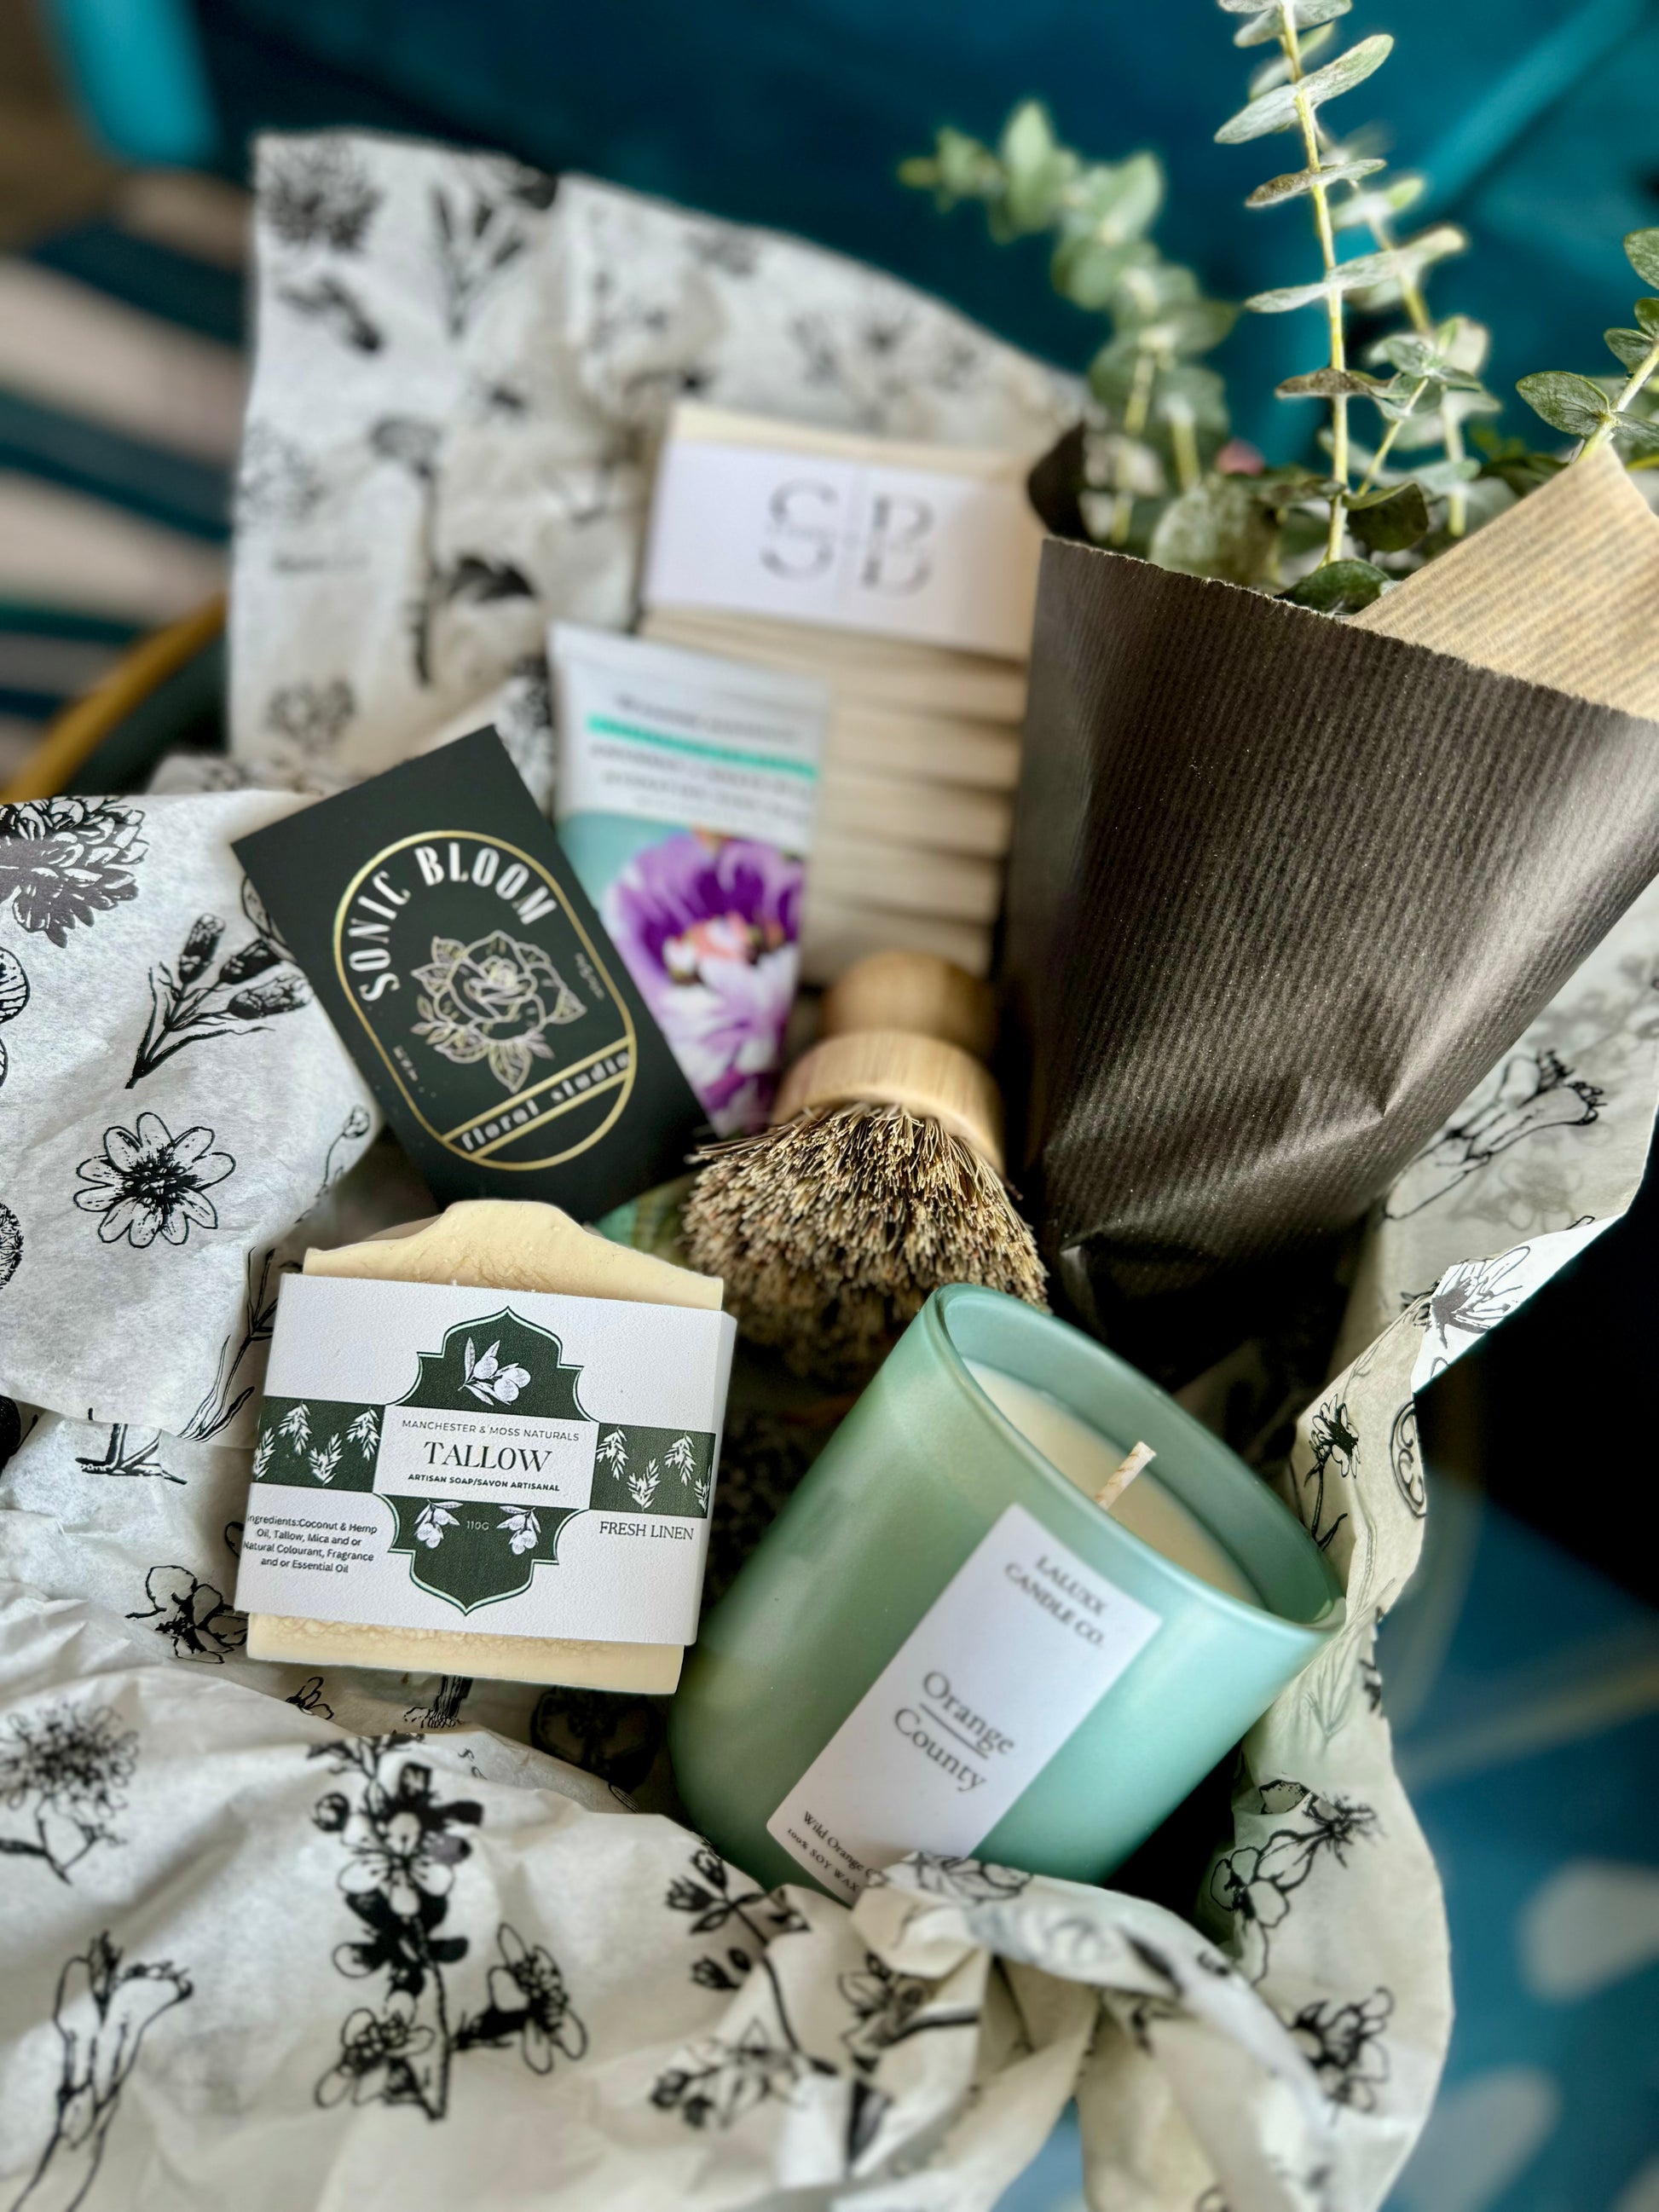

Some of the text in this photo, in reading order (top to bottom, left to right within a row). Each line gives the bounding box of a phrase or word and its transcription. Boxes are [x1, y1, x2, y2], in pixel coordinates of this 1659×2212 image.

[348, 842, 557, 1002] SONIC BLOOM
[461, 1052, 629, 1151] floral studio
[402, 1420, 477, 1434] MANCHESTER
[489, 1427, 520, 1436] MOSS
[524, 1429, 580, 1441] NATURALS
[424, 1441, 552, 1472] TALLOW
[408, 1474, 560, 1492] ARTISAN SOAP/SAVON ARTISANAL
[257, 1528, 271, 1539] Oil,
[274, 1530, 305, 1542] Tallow,
[308, 1533, 329, 1543] Mica
[332, 1536, 350, 1545] and
[349, 1523, 378, 1534] Hemp
[466, 1520, 489, 1531] 110G
[599, 1521, 694, 1540] FRESH LINEN
[243, 1540, 374, 1562] Natural Colourant, Fragrance
[261, 1557, 278, 1566] and
[292, 1559, 332, 1572] Essential
[335, 1563, 349, 1573] Oil
[1036, 1556, 1107, 1617] LALUXX
[1005, 1563, 1104, 1648] CANDLE CO.
[923, 1672, 1014, 1754] Orange
[894, 1708, 986, 1792] County
[804, 1811, 864, 1871] Wild Orange
[788, 1828, 809, 1850] 100%
[810, 1849, 832, 1869] SOY
[835, 1868, 859, 1892] WAX
